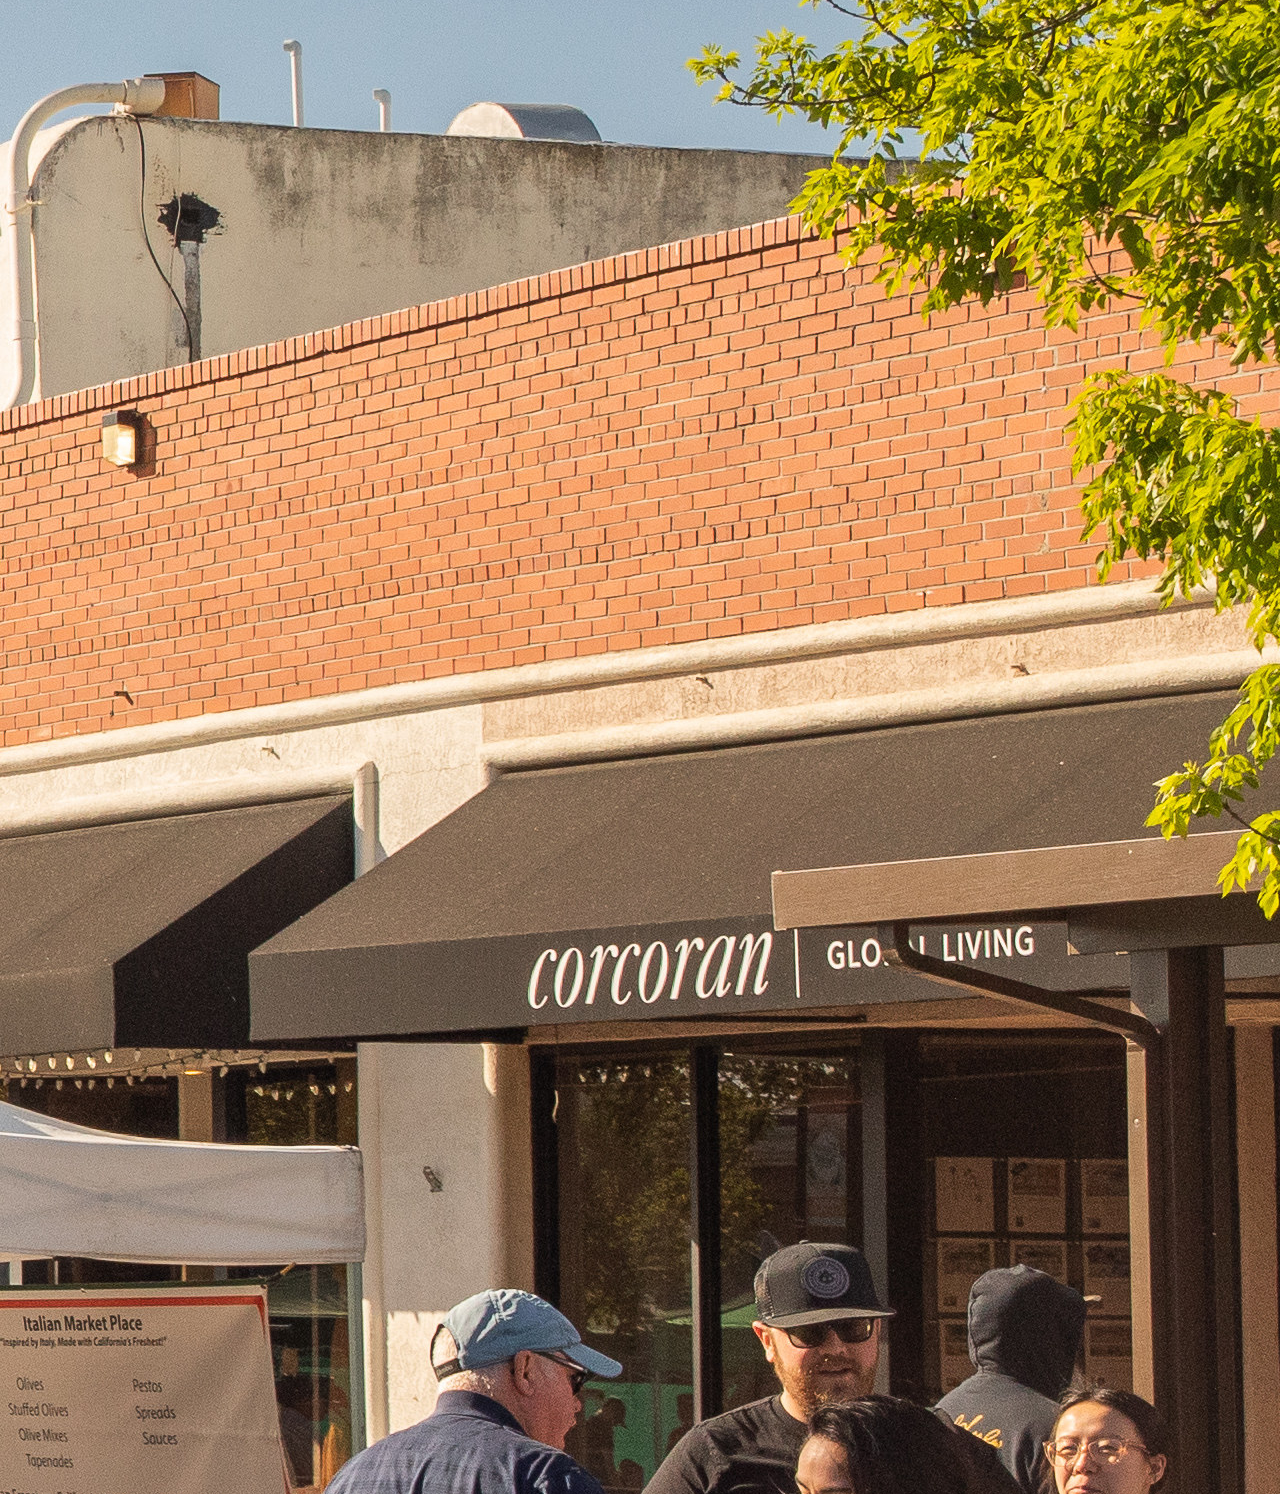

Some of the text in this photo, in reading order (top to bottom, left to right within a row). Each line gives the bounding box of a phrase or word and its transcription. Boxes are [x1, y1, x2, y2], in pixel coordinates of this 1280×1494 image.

[527, 925, 1035, 1009] corcoran GLOL LIVING
[22, 1314, 143, 1332] Italian Market Place
[30, 1336, 39, 1349] by
[57, 1337, 77, 1347] Made
[77, 1336, 92, 1347] with
[16, 1377, 45, 1392] Olives
[132, 1379, 163, 1394] Pestos
[7, 1402, 69, 1417] Stuffed Olives
[135, 1405, 176, 1421] Spreads
[18, 1427, 68, 1443] Olive Mixes
[142, 1431, 178, 1447] Sauces
[25, 1453, 75, 1470] Tapenades
